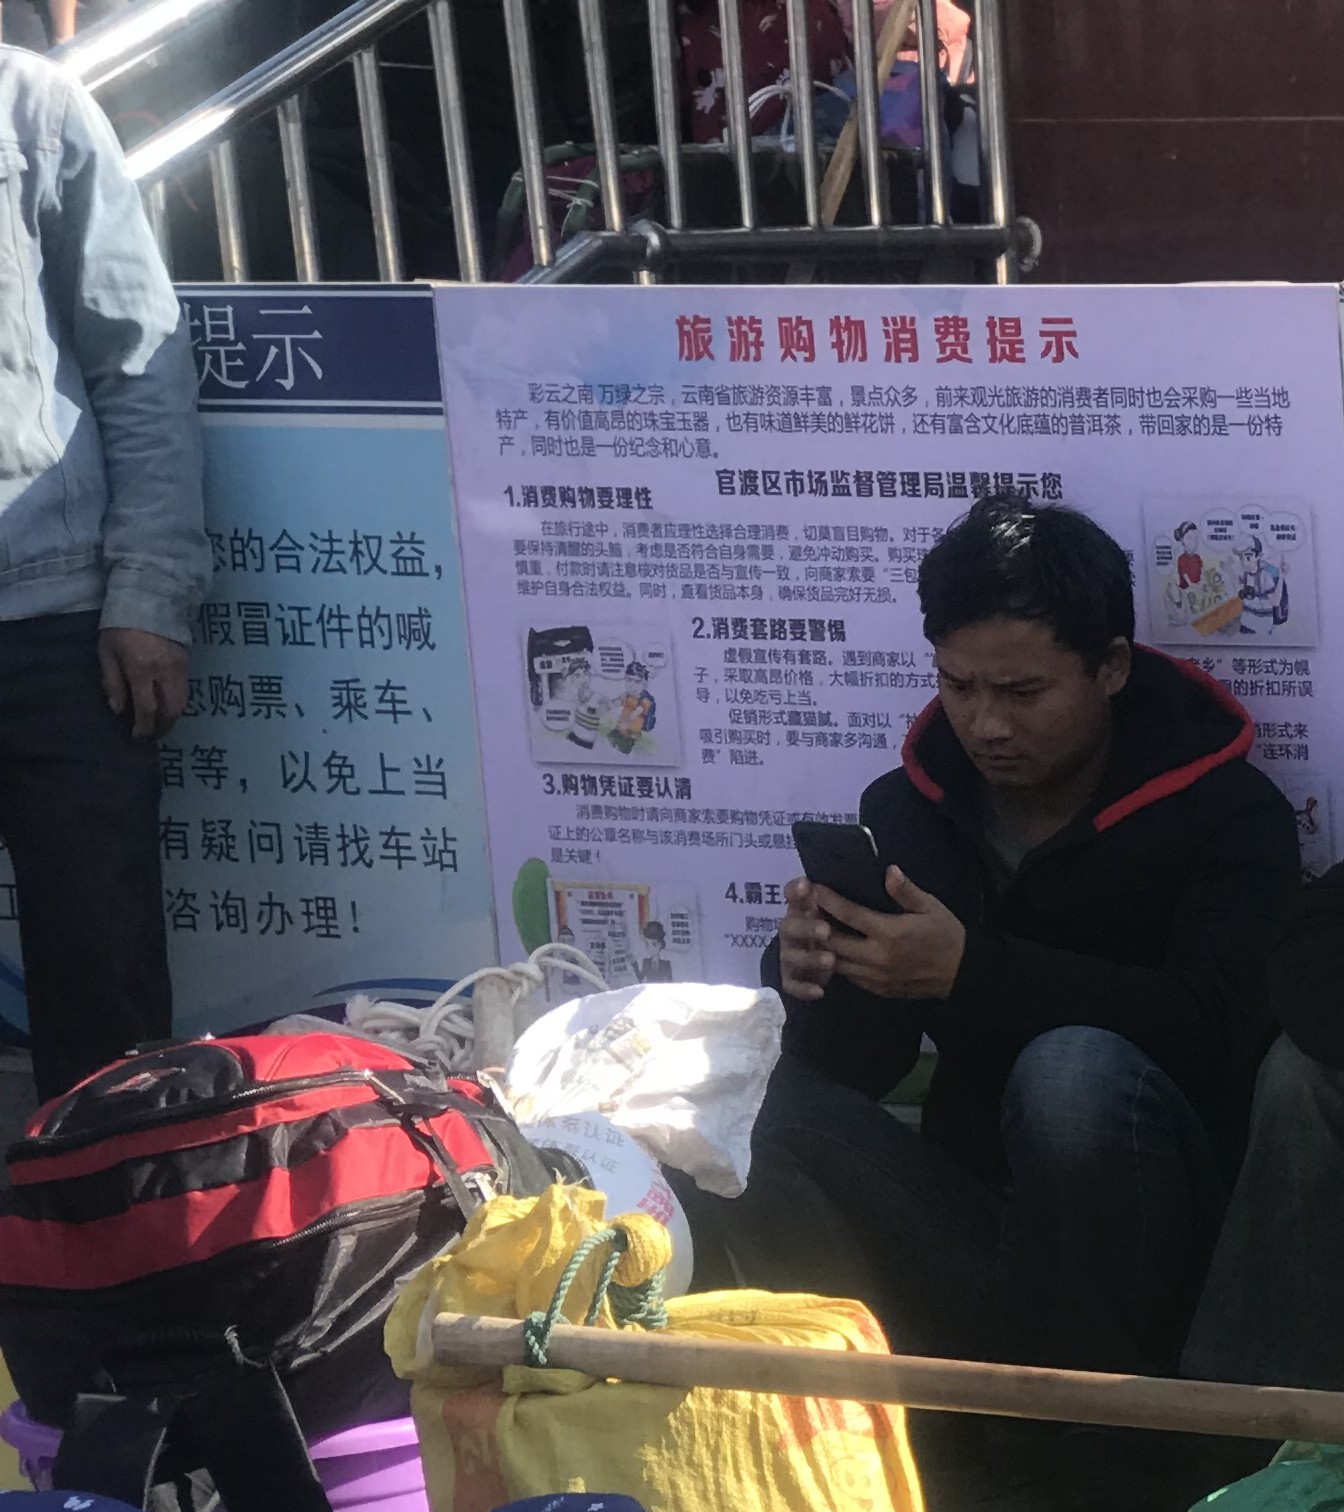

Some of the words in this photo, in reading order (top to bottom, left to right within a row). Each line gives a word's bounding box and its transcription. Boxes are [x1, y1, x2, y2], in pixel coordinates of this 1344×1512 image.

[190, 303, 323, 391] 提示
[675, 315, 1080, 364] 旅游购物消费提示
[504, 485, 654, 510] 1.消费购物要理性
[716, 469, 1063, 500] 官渡区市场监督管理局温馨提示您
[191, 602, 436, 653] 假冒证件的喊
[692, 617, 846, 642] 2.消费套路要警惕
[724, 648, 936, 668] 虚假宣传有套路。遇到商家以“
[700, 728, 904, 749] 吸引购买时，要与商家多沟通，
[543, 773, 692, 800] 3.购物凭证要认清
[160, 815, 459, 873] 有疑问请找车站
[725, 881, 789, 905] 4.霸王
[165, 888, 360, 940] 咨询办理！
